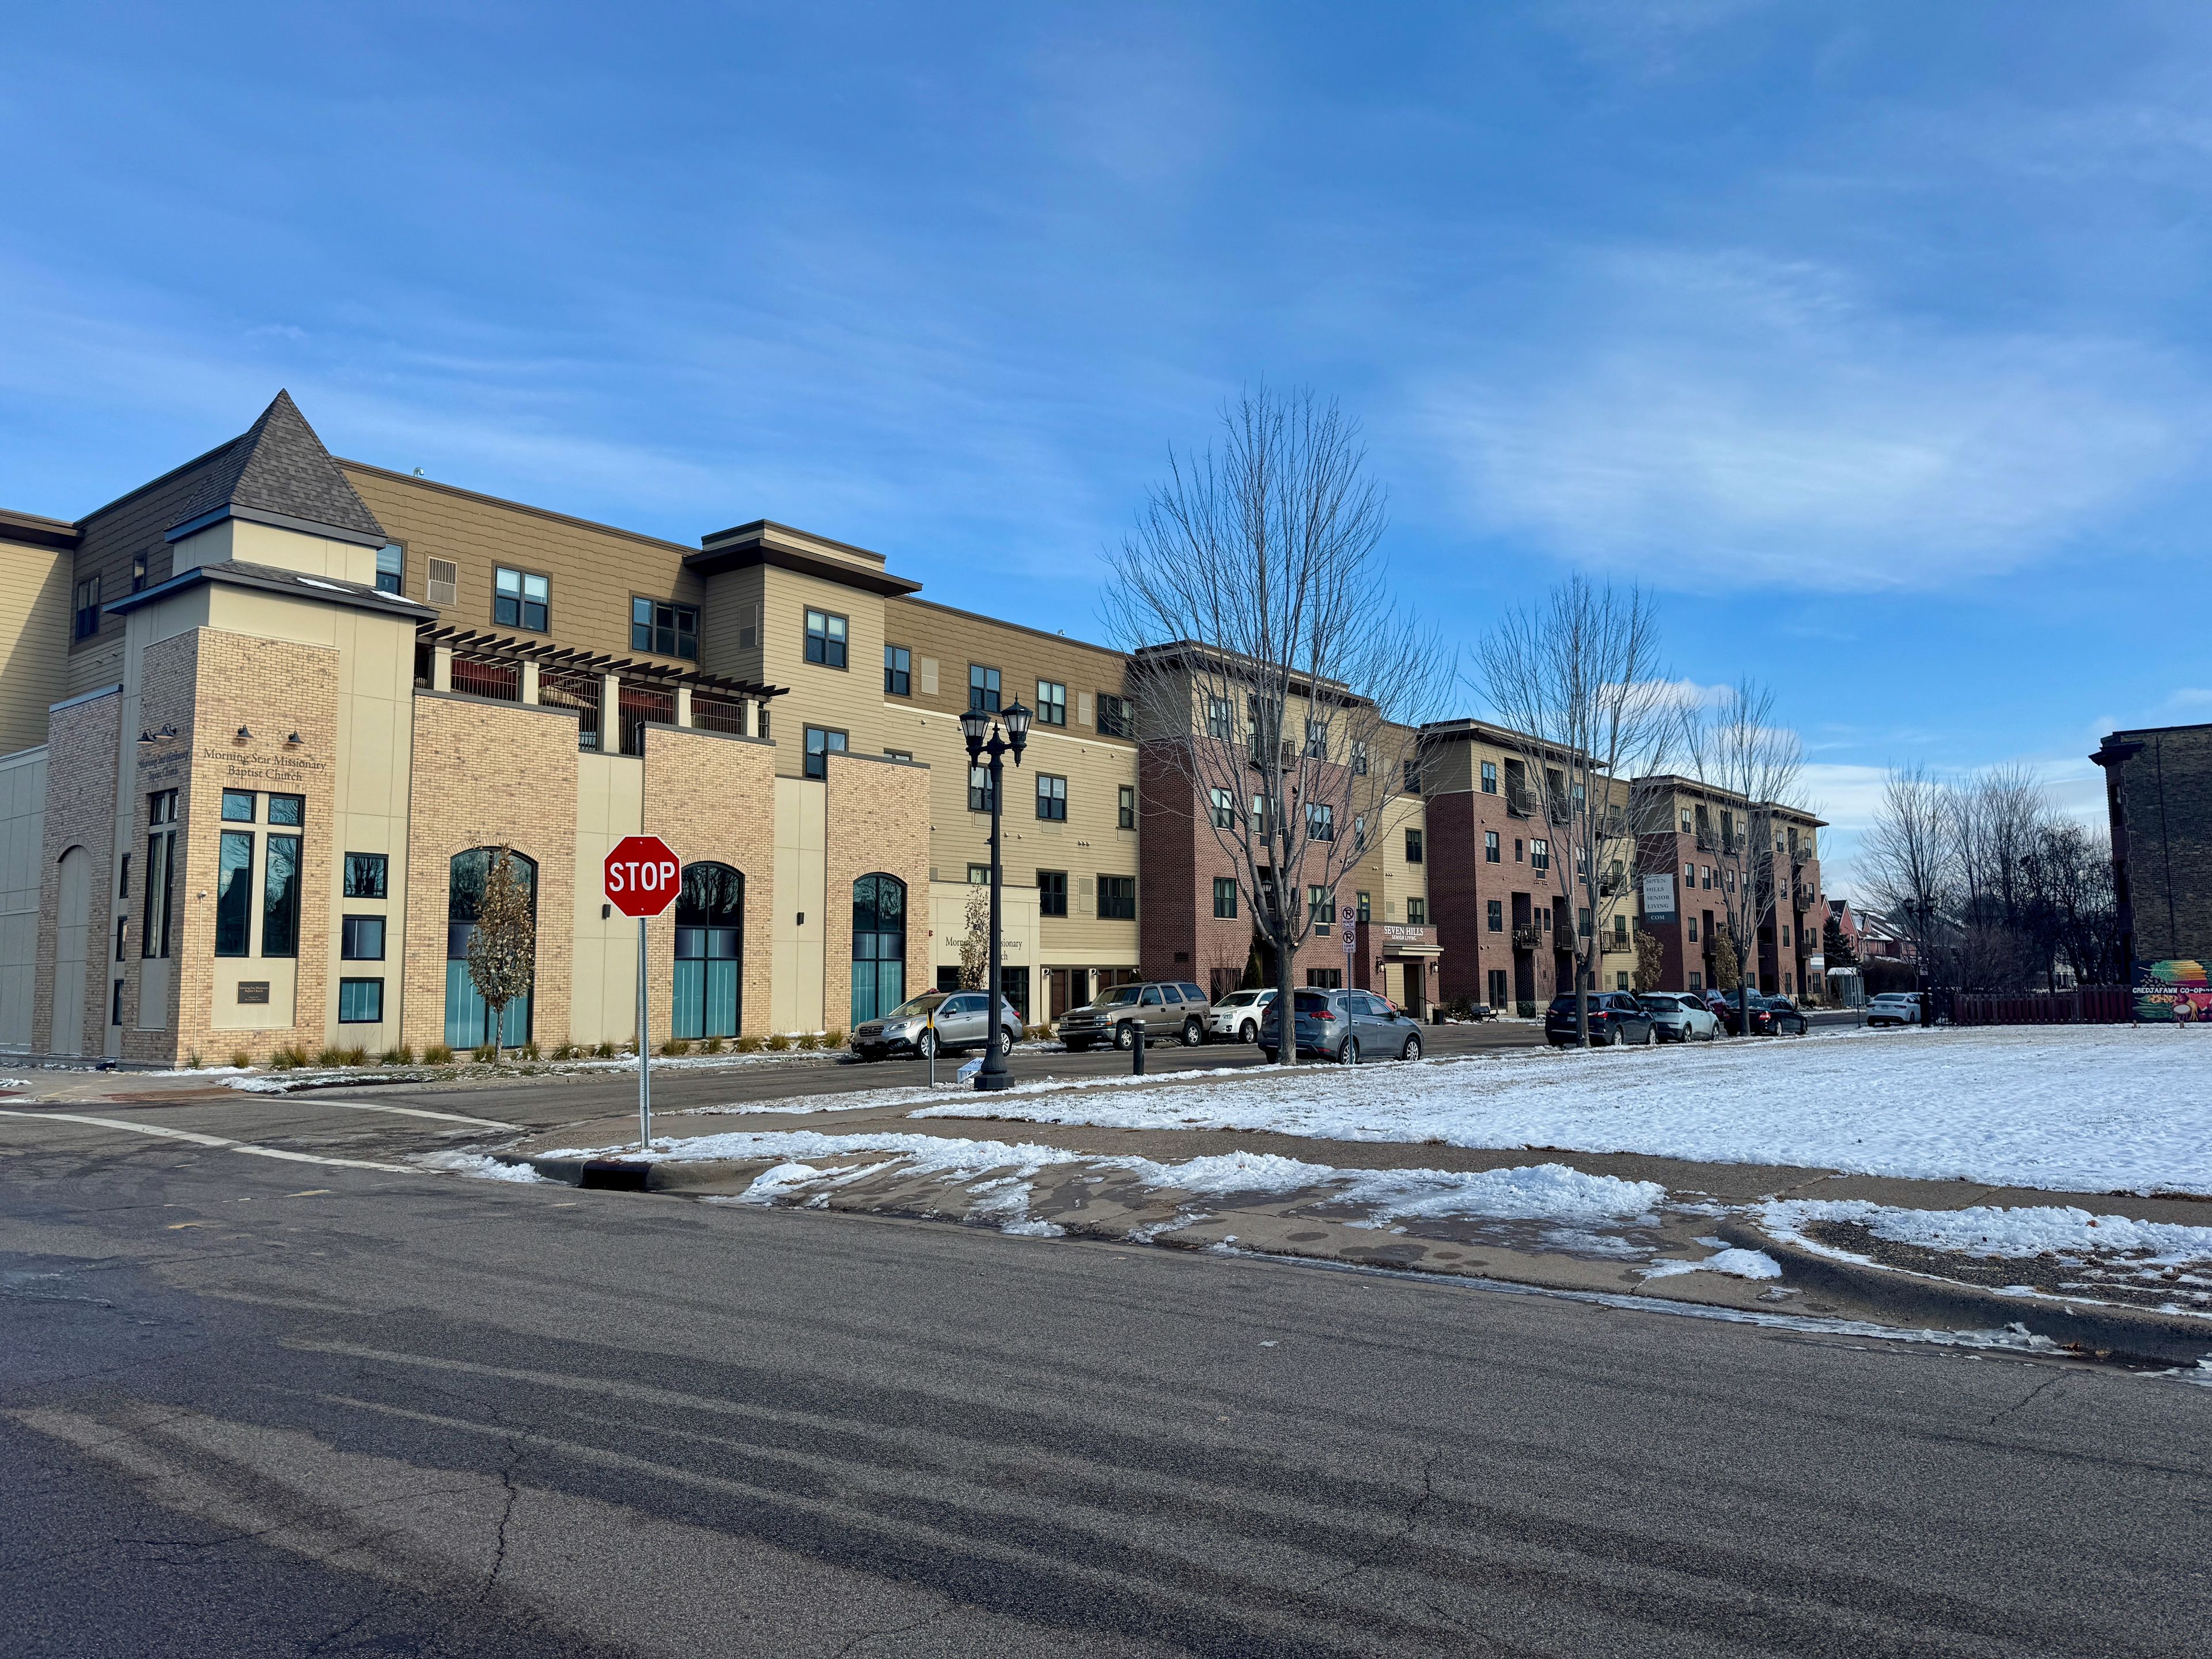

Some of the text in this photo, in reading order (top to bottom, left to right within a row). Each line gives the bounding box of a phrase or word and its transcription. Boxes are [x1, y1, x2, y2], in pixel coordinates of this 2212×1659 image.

[203, 748, 326, 772] Morning Star Missionary
[228, 765, 303, 781] Baptist Church
[609, 862, 675, 892] STOP
[1384, 926, 1423, 936] SEVEN HILLS
[946, 937, 971, 946] Mornin
